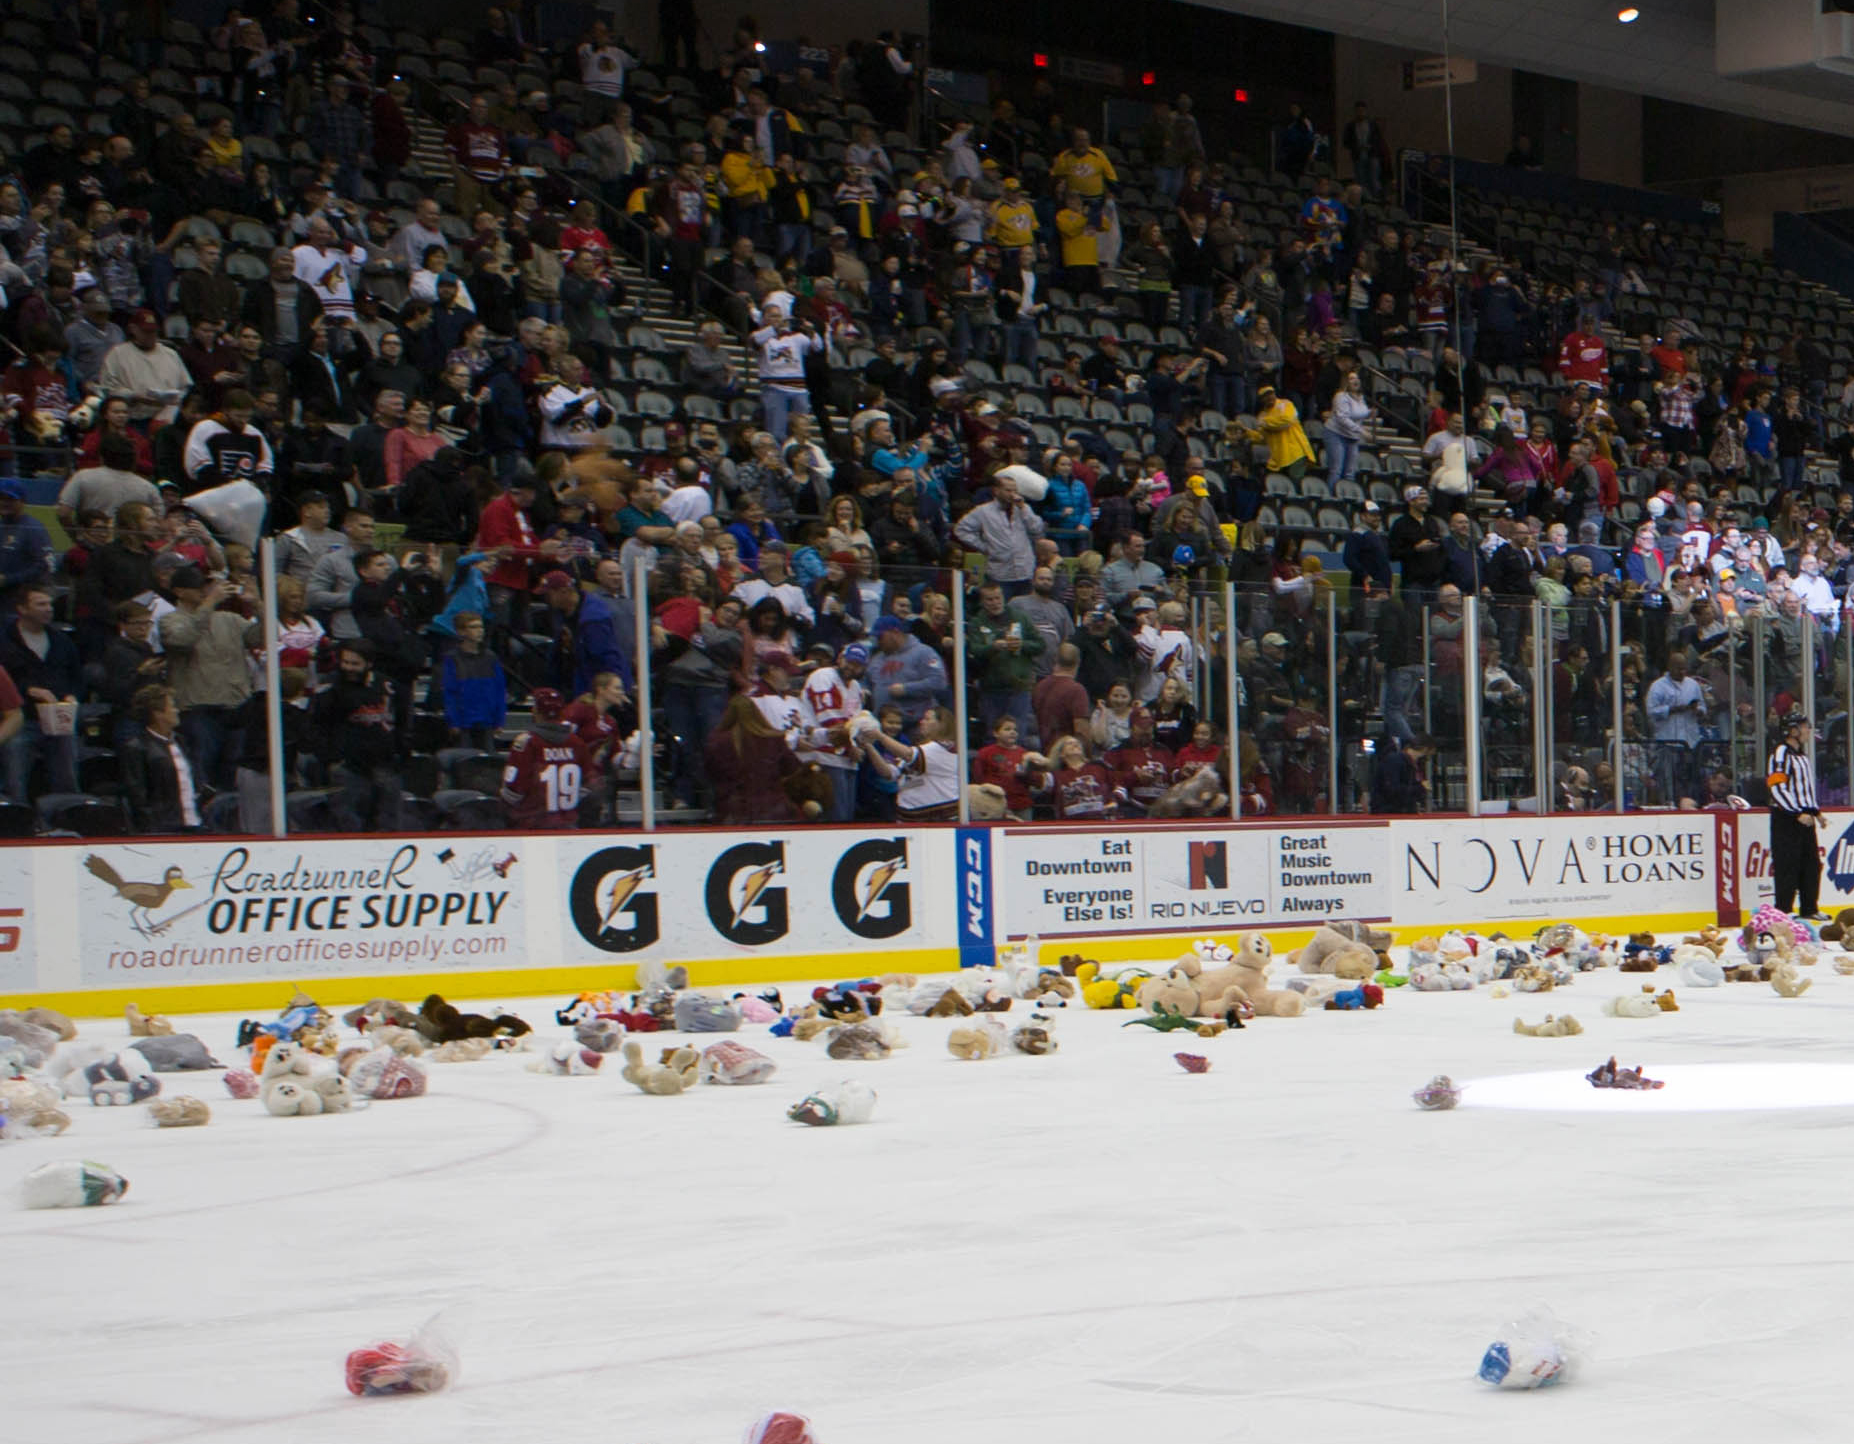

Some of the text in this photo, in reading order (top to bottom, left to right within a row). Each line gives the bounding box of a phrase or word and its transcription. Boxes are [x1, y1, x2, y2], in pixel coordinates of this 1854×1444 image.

[539, 763, 582, 812] 19
[1101, 838, 1133, 856] Eat
[1280, 835, 1327, 851] Great
[1603, 833, 1704, 858] HOME
[1026, 858, 1133, 876] Downtown
[1280, 853, 1332, 869] Music
[1281, 870, 1372, 887] Downtown
[1603, 860, 1705, 884] LOANS
[963, 837, 984, 940] CCM
[1043, 886, 1133, 906] Everyone
[206, 890, 510, 935] OFFICE SUPPLY
[1064, 904, 1134, 923] Else Is!
[1151, 898, 1265, 919] RIO NUEVO
[1281, 896, 1344, 915] Always
[107, 932, 507, 971] roadrunnerofficesupply.com
